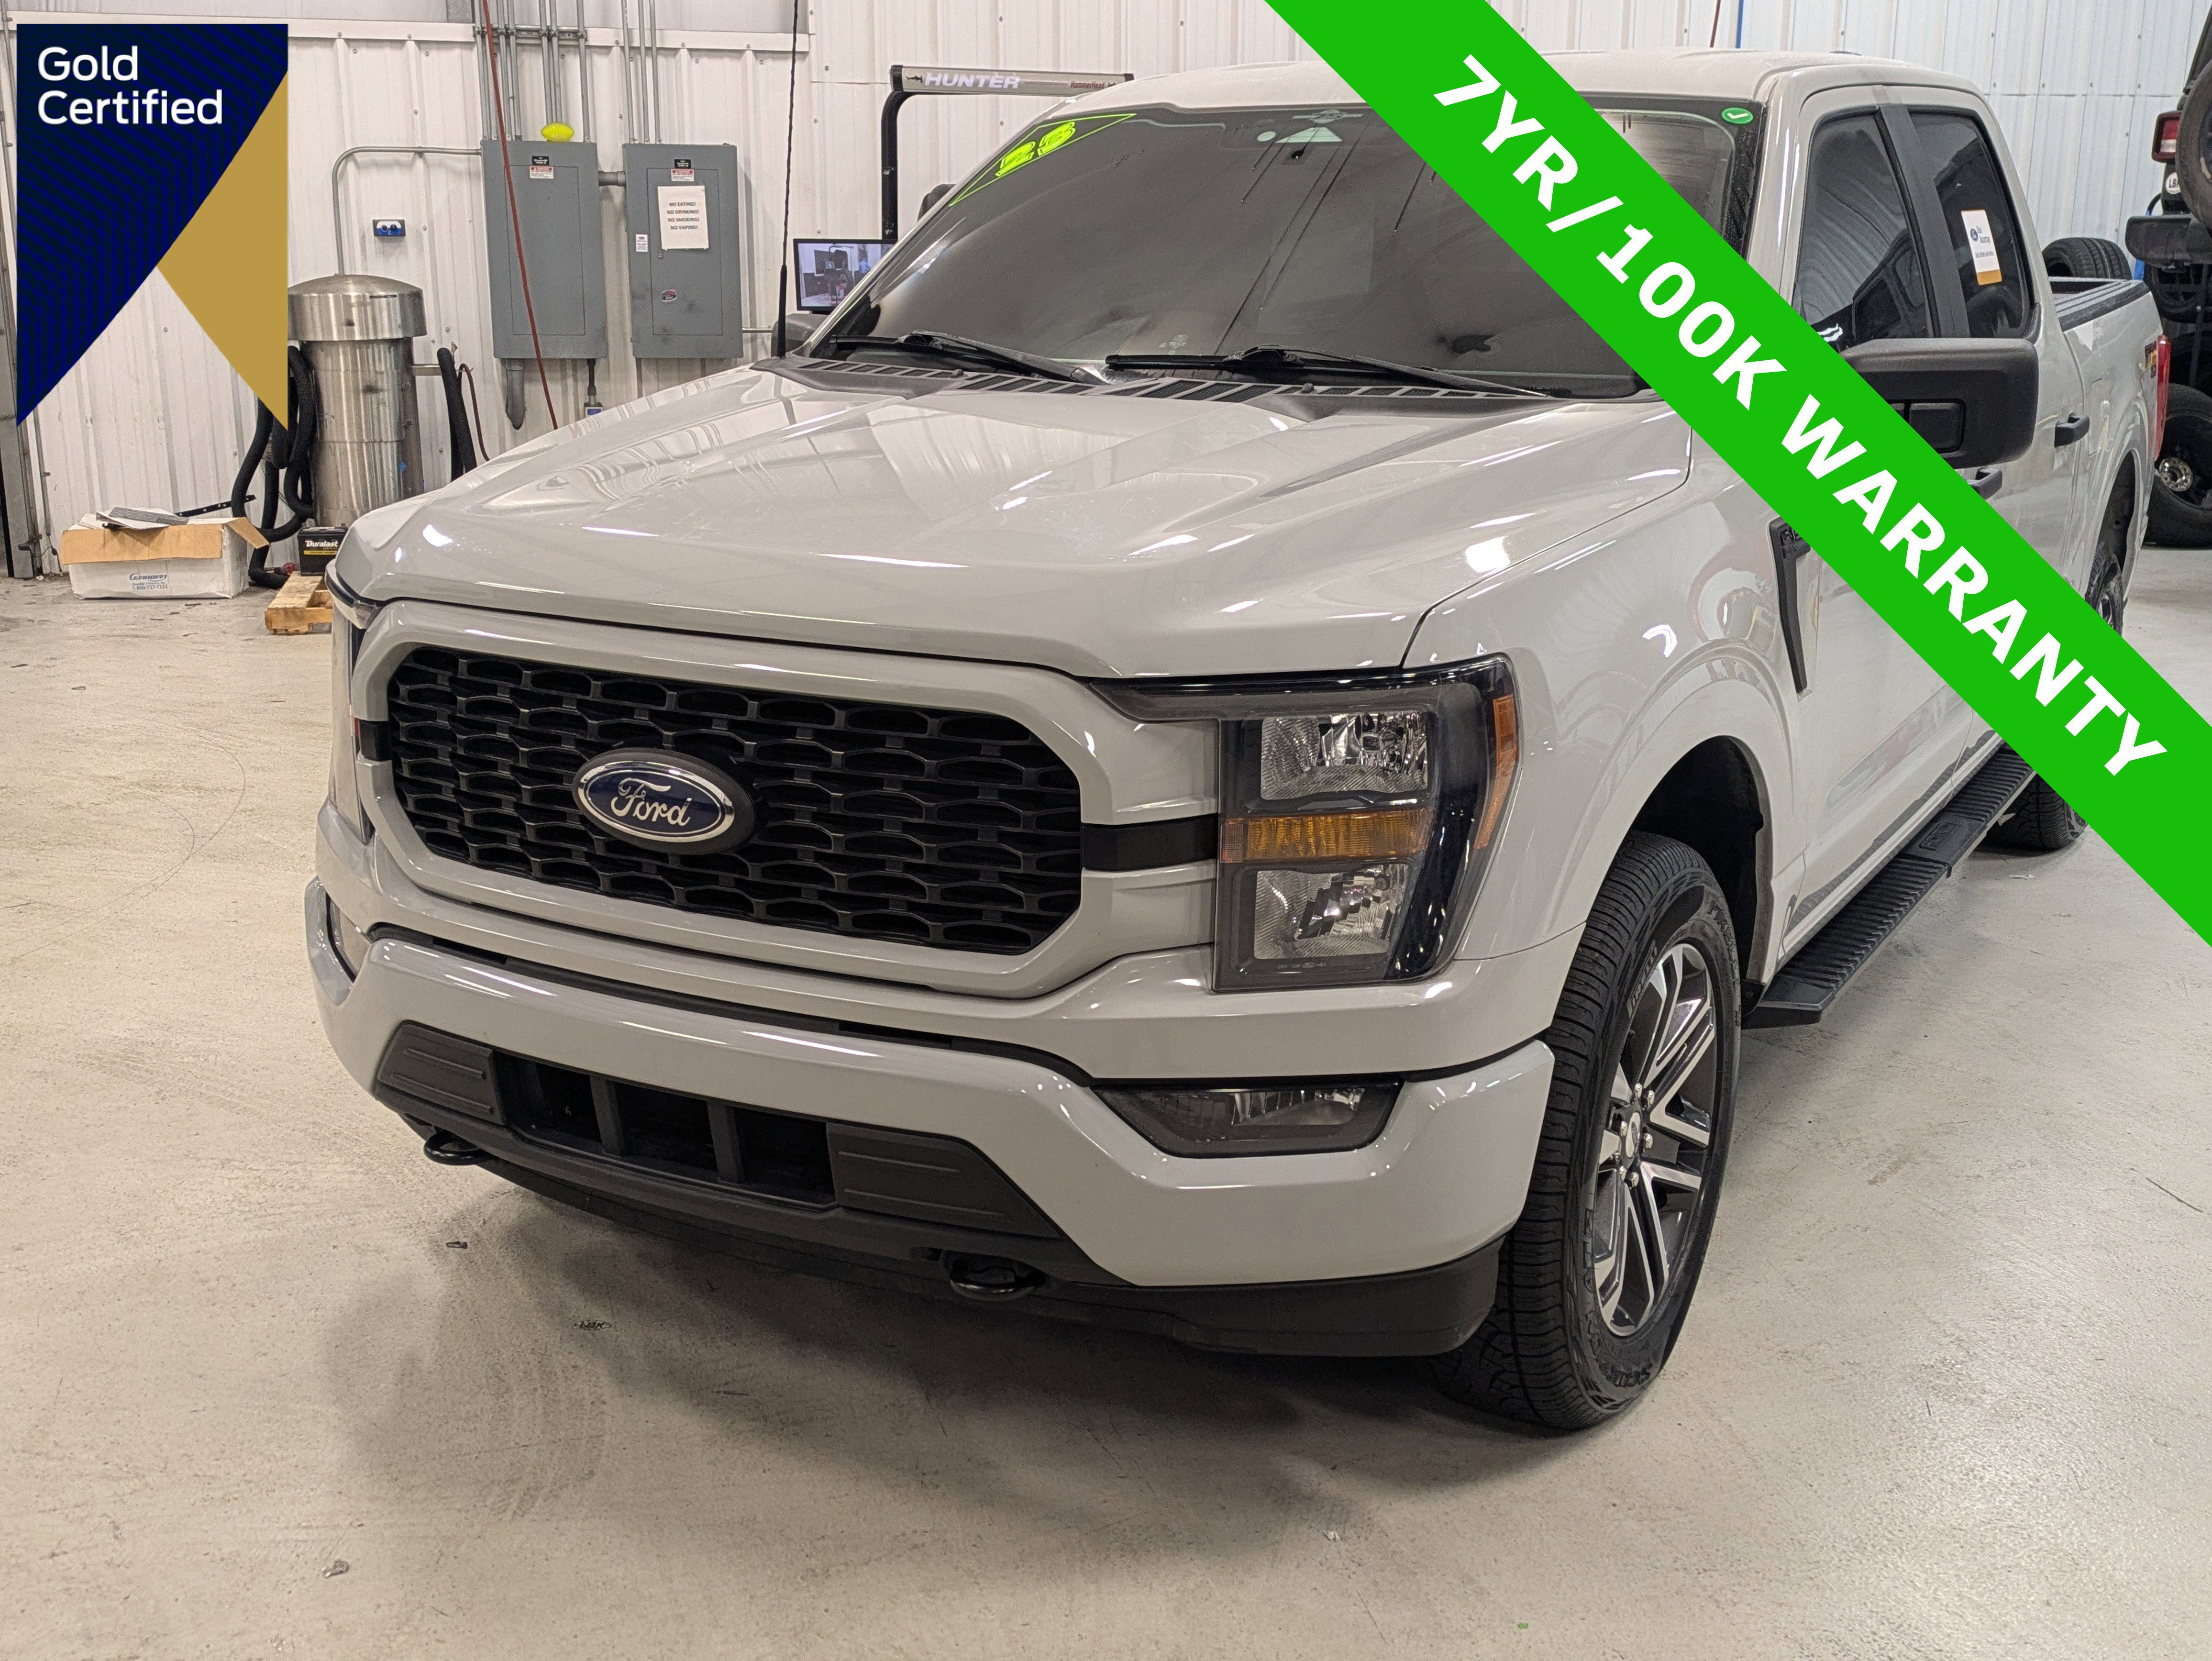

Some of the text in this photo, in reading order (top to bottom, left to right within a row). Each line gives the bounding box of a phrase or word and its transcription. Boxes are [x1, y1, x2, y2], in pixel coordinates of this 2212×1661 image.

[925, 73, 1020, 89] HUNTER
[995, 122, 1075, 177] 23
[2169, 178, 2179, 188] LB
[611, 777, 692, 826] Ford
